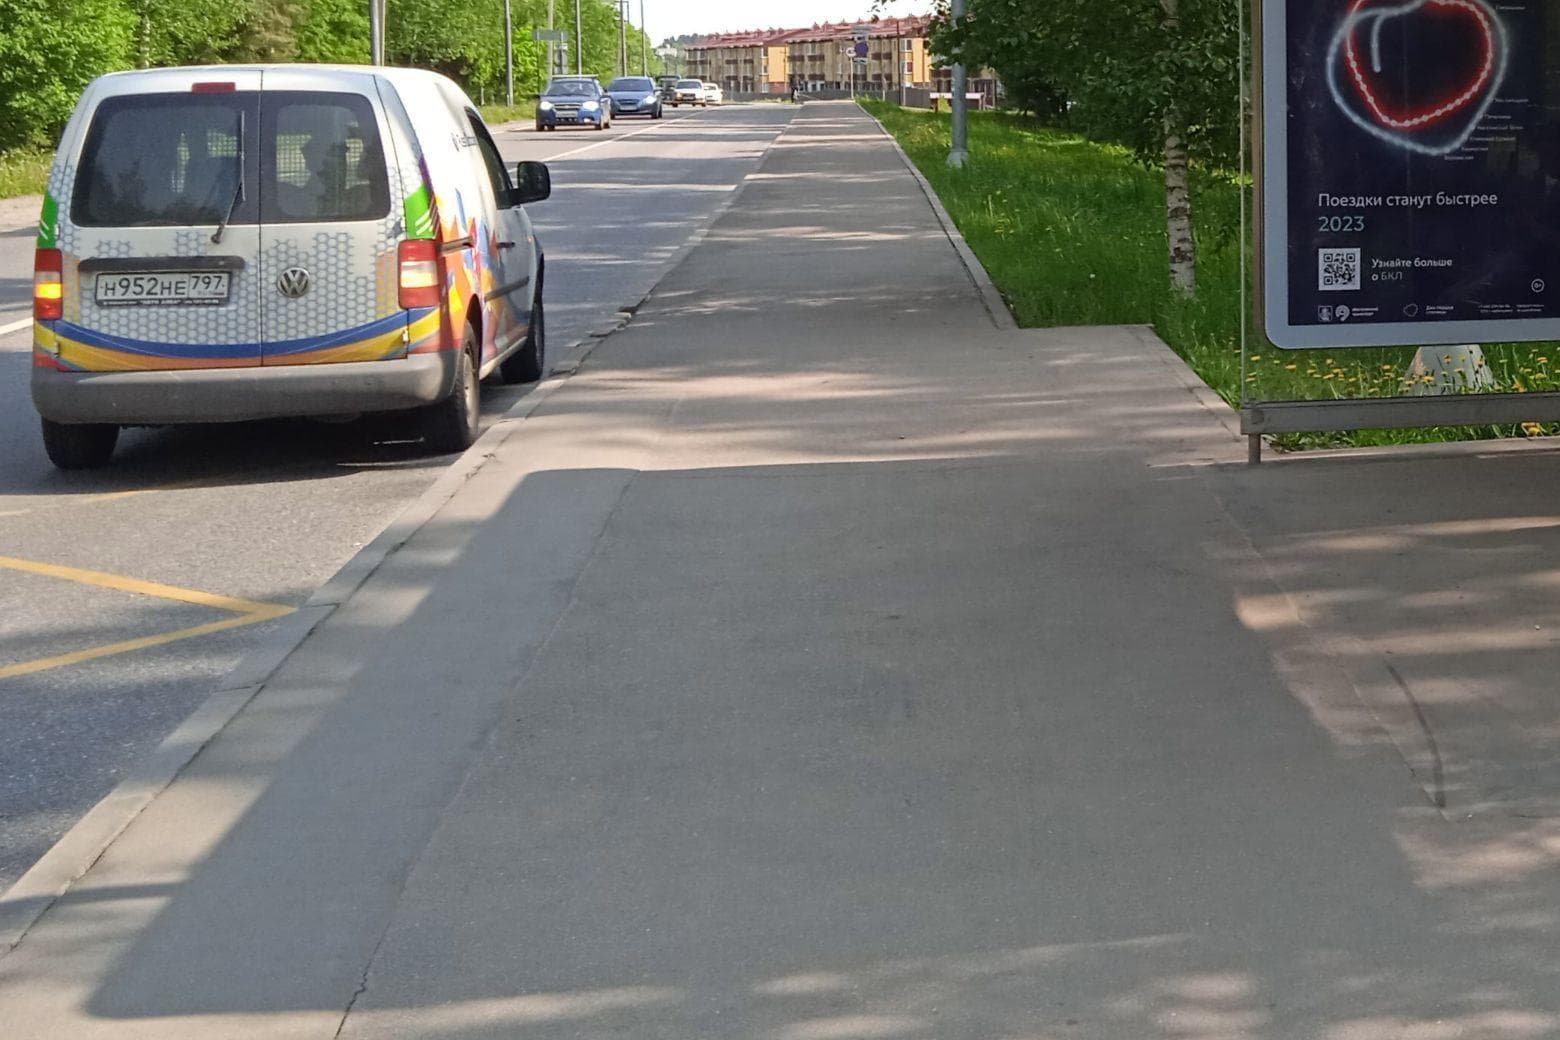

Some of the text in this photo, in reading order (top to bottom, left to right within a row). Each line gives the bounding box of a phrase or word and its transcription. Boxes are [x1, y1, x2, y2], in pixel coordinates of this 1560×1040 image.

[1318, 192, 1498, 208] Поездки станут быстрее
[1318, 216, 1365, 232] 2023
[1371, 257, 1453, 269] Узнайте больше
[1371, 271, 1403, 281] о БКЛ
